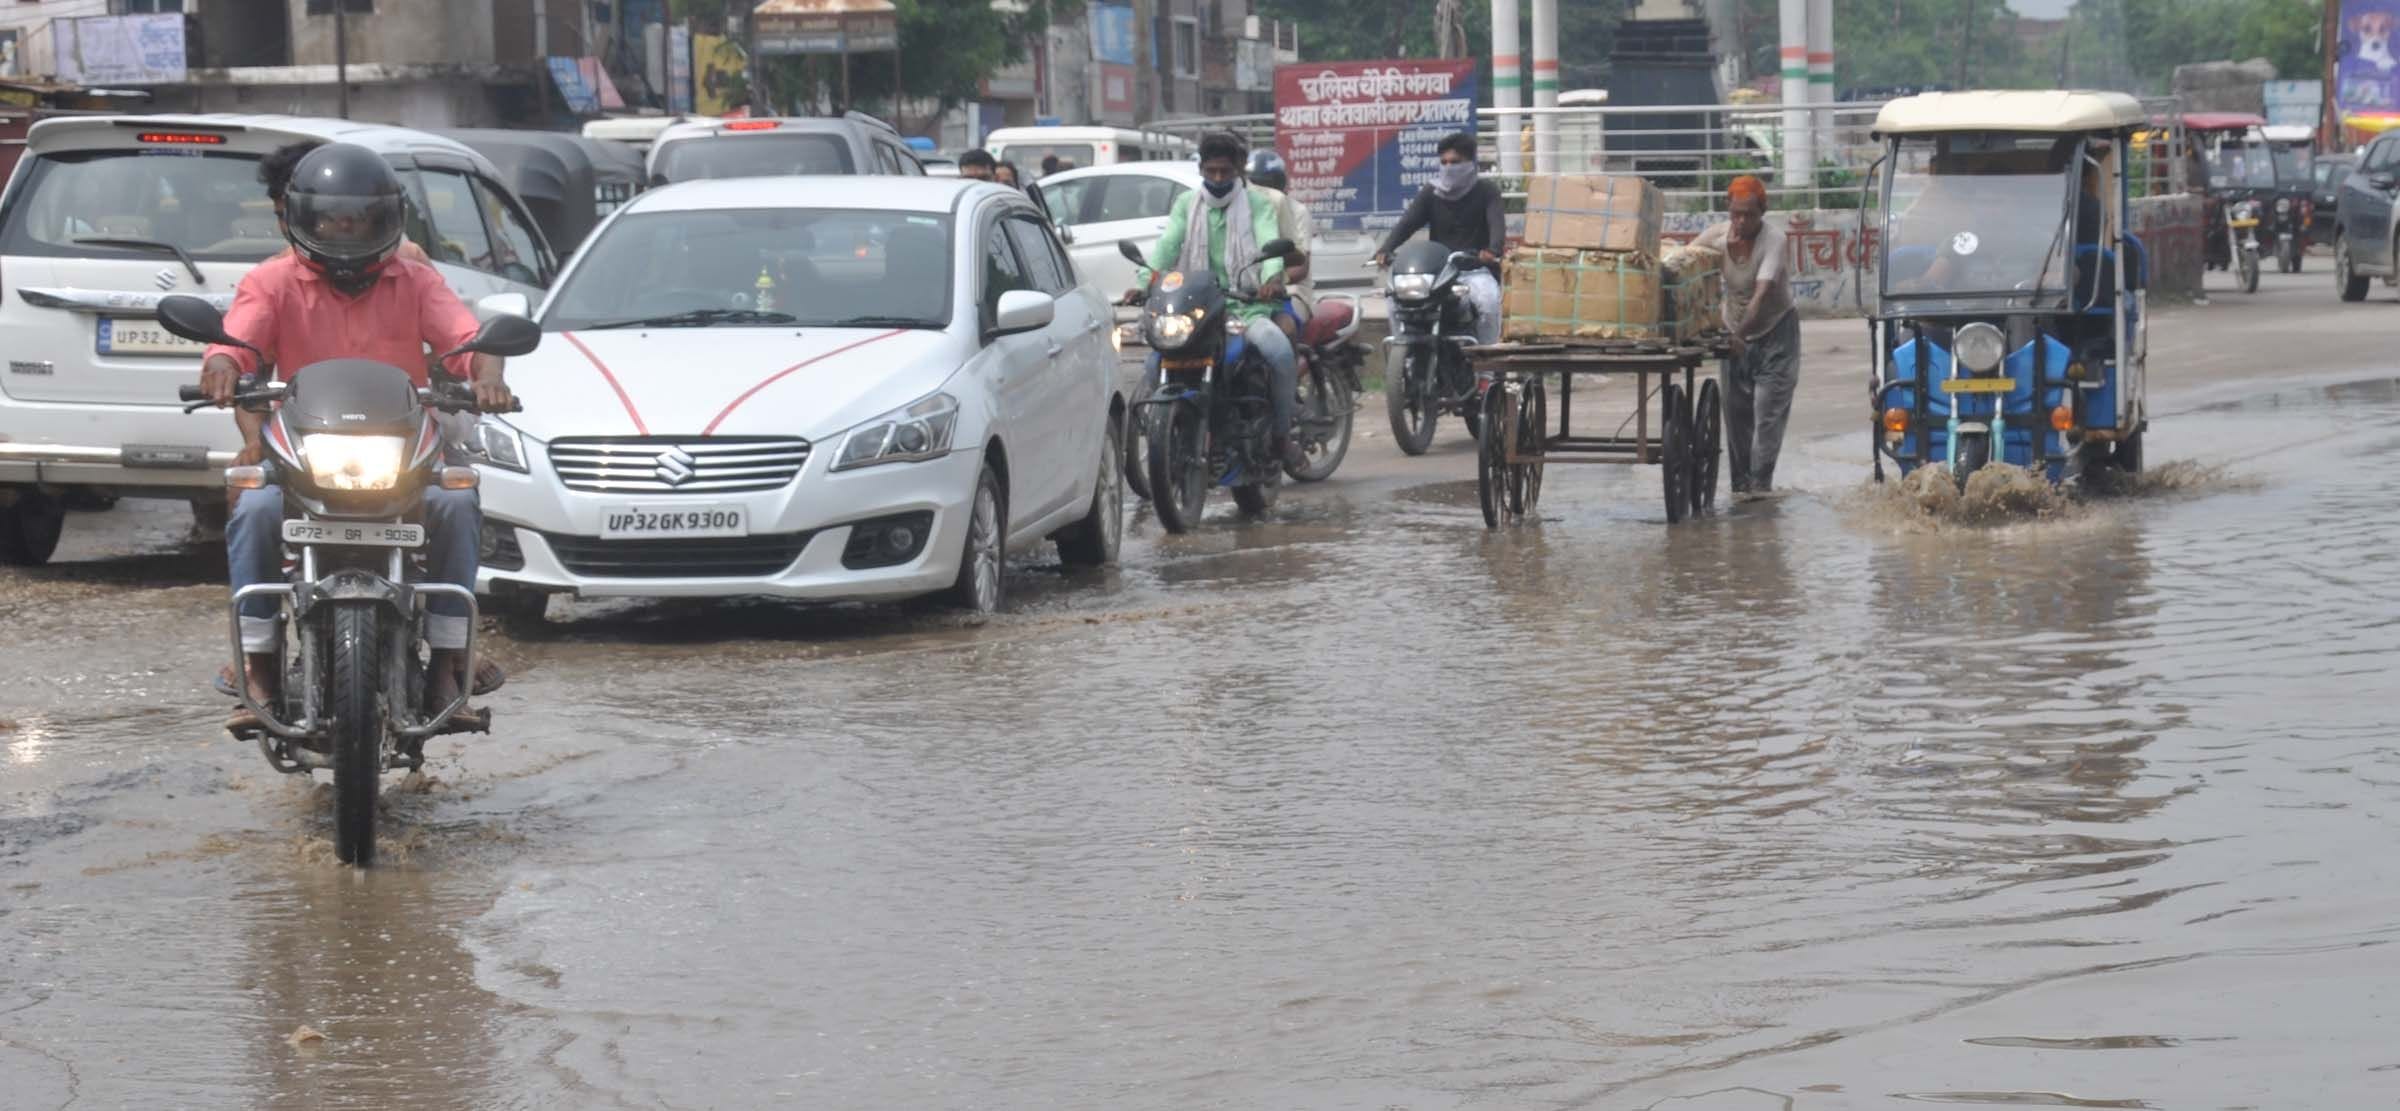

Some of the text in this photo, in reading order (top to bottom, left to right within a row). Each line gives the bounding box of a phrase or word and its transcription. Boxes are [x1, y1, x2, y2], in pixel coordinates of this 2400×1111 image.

[1299, 70, 1358, 100] पुलिस
[1359, 68, 1405, 98] चौकी
[1280, 104, 1319, 126] थाना
[1784, 212, 1841, 273] ाँच
[117, 330, 160, 345] UP32
[289, 526, 322, 539] UP72
